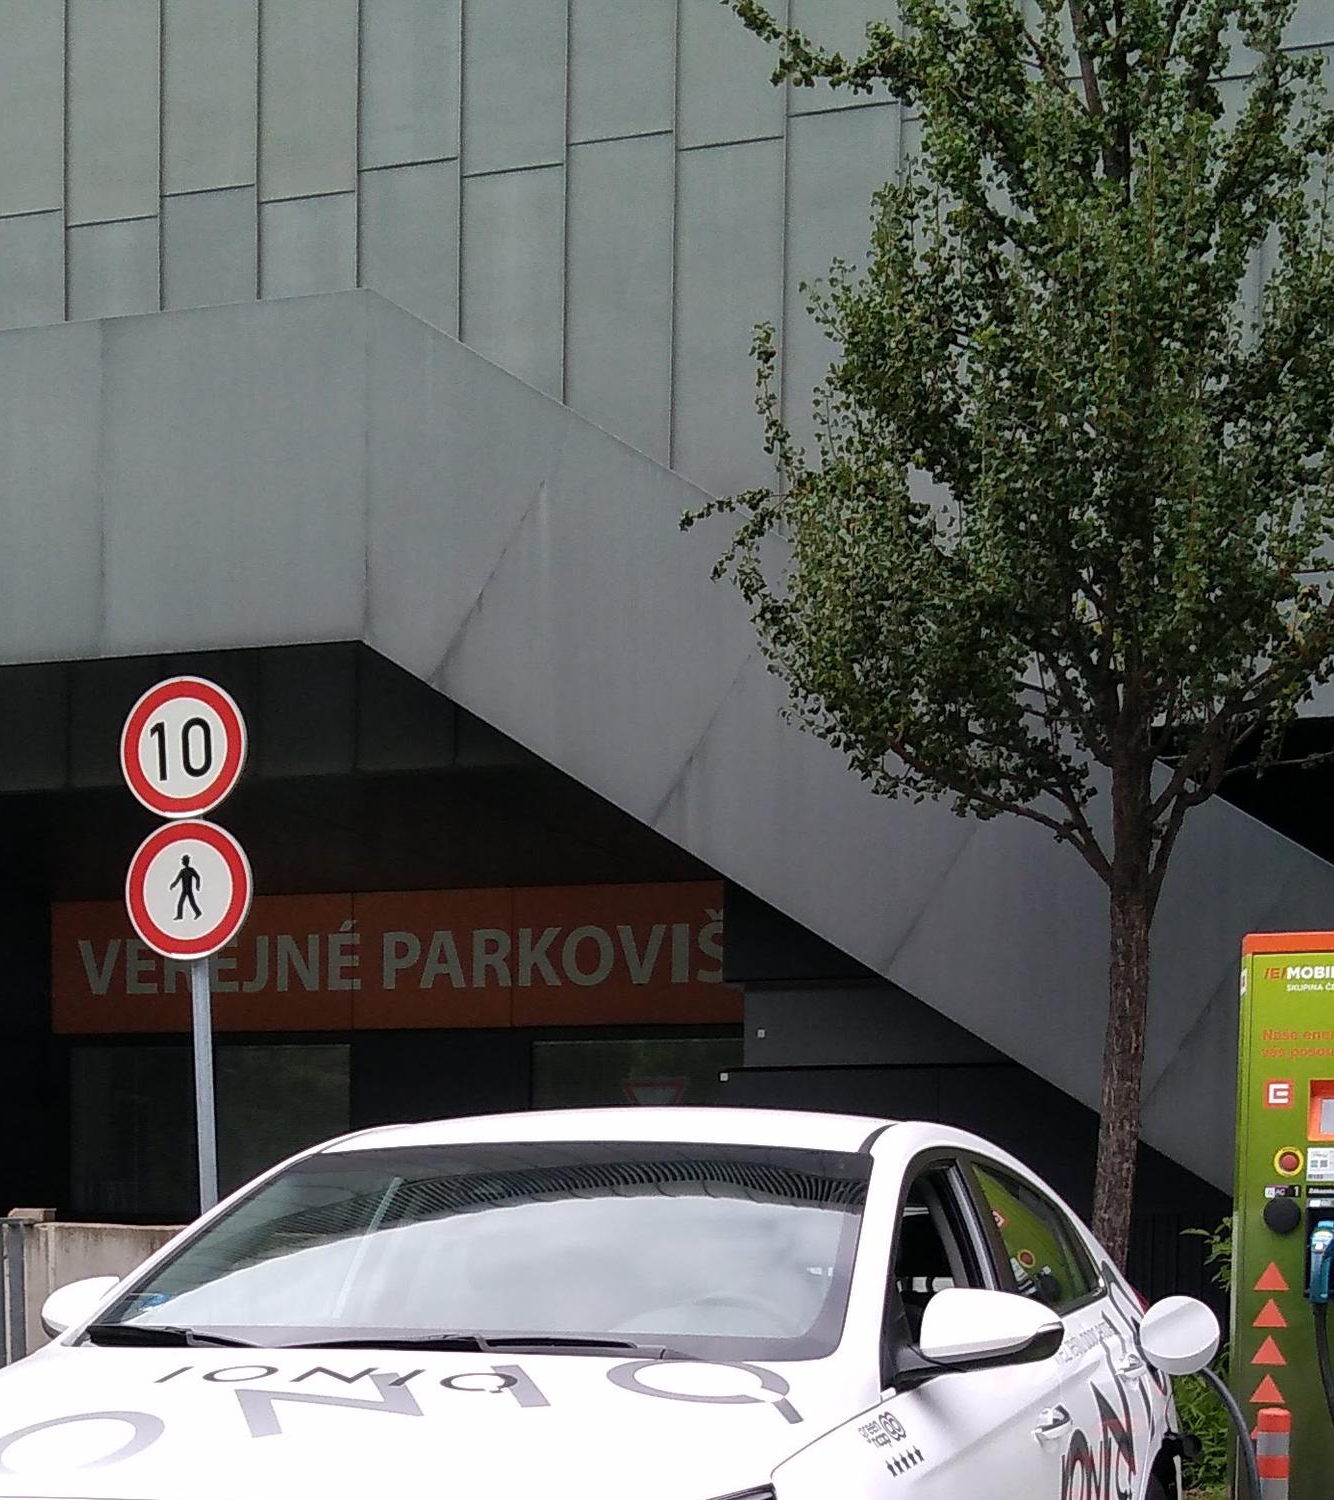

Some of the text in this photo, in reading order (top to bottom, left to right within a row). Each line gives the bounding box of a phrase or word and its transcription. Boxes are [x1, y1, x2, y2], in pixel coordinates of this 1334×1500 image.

[149, 717, 213, 781] 10
[1286, 984, 1324, 992] SKUPINA
[1294, 1186, 1299, 1197] 1
[154, 1364, 519, 1393] IONIQ
